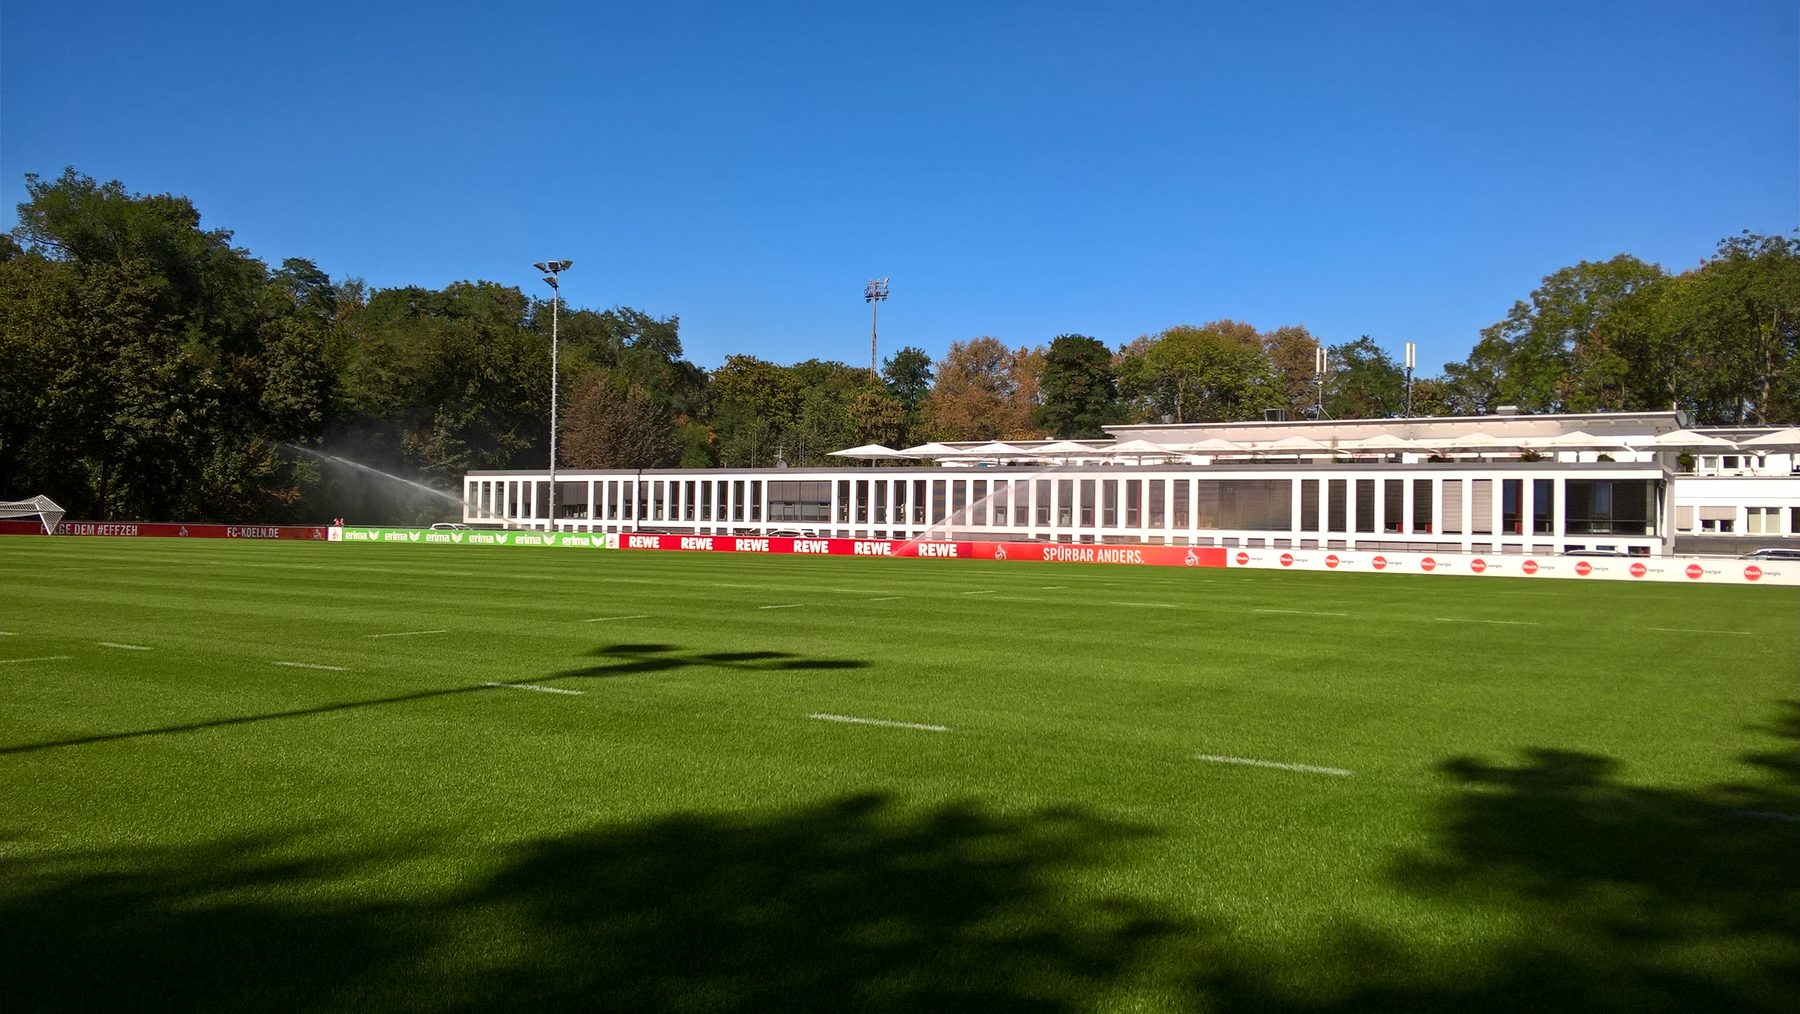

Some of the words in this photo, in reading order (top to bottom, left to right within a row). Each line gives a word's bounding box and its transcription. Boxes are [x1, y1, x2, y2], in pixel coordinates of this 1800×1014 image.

[74, 524, 95, 535] DEM
[97, 525, 138, 536] #EFFZEH
[227, 527, 279, 538] FC-KOELN.DE
[345, 531, 367, 540] erima
[385, 532, 407, 541] erima
[426, 532, 450, 542] erima
[469, 533, 493, 543] erima
[515, 534, 541, 544] erima
[562, 535, 589, 545] erima
[629, 535, 659, 549] REWE
[681, 537, 713, 550] REWE
[736, 539, 769, 552] REWE
[794, 540, 828, 553] REWE
[854, 541, 891, 555] REWE
[919, 543, 957, 557] REWE
[1043, 545, 1094, 562] SPÜRBAR
[1097, 549, 1145, 564] ANDERS.
